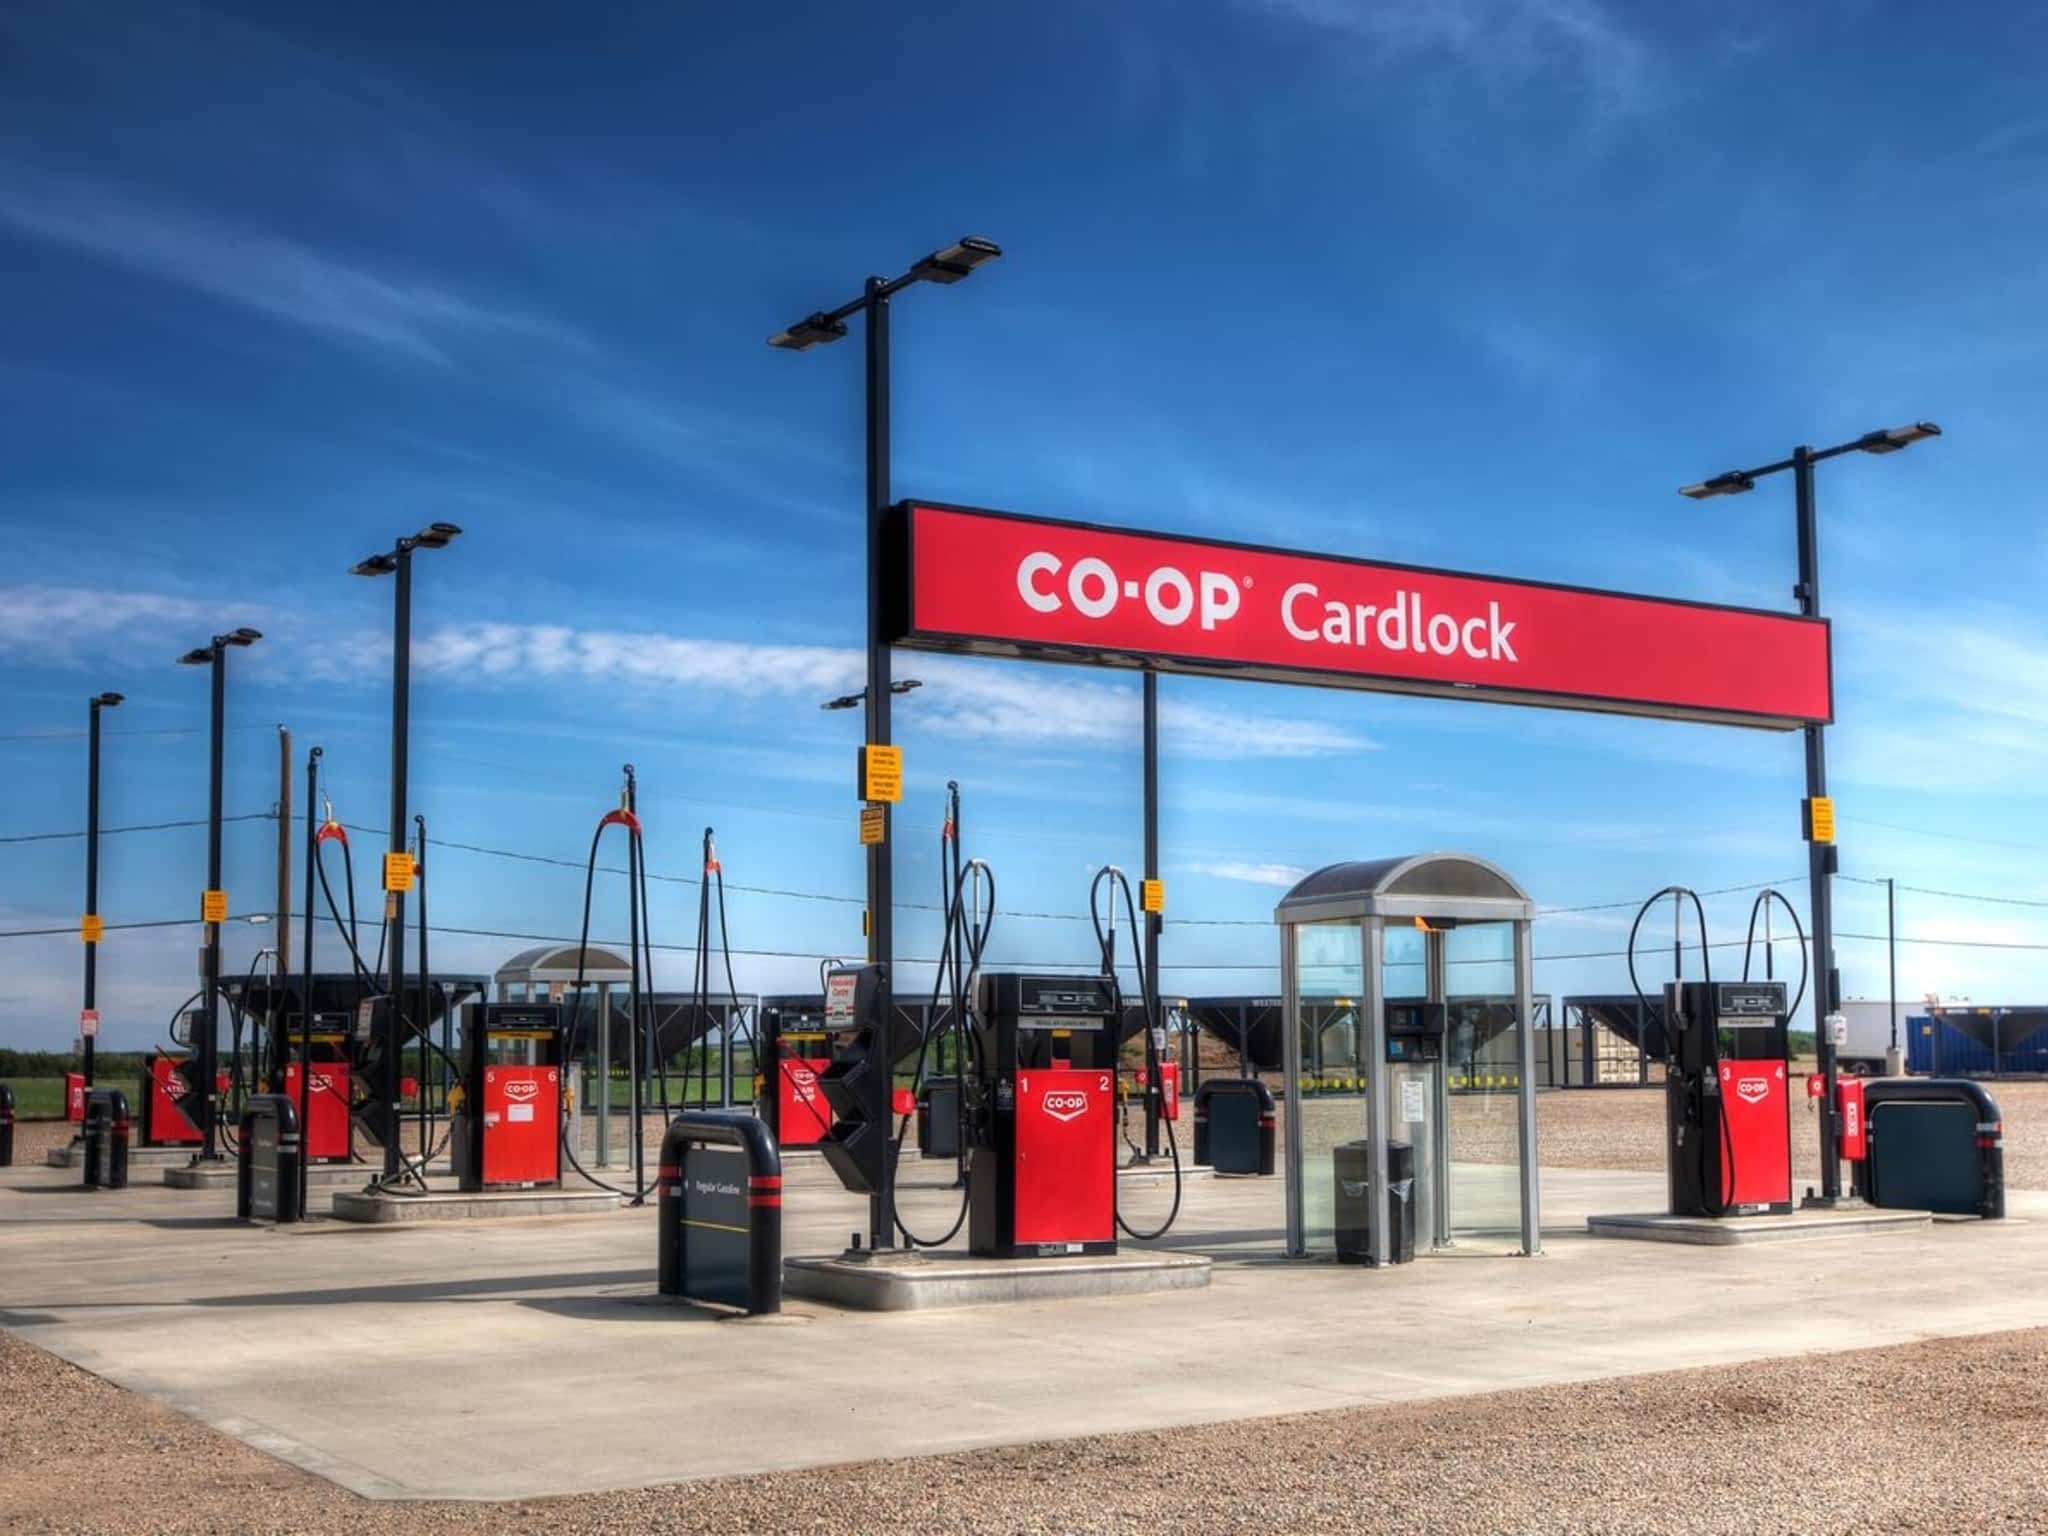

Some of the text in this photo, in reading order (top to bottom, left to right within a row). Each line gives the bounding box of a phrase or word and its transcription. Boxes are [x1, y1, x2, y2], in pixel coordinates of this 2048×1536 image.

[1281, 583, 1518, 663] Cardlock
[487, 1070, 558, 1082] 5 6
[1722, 1067, 1732, 1081] 3
[1775, 1065, 1784, 1079] 4
[1020, 1075, 1110, 1093] 1 2
[1046, 1098, 1084, 1109] CO-OP
